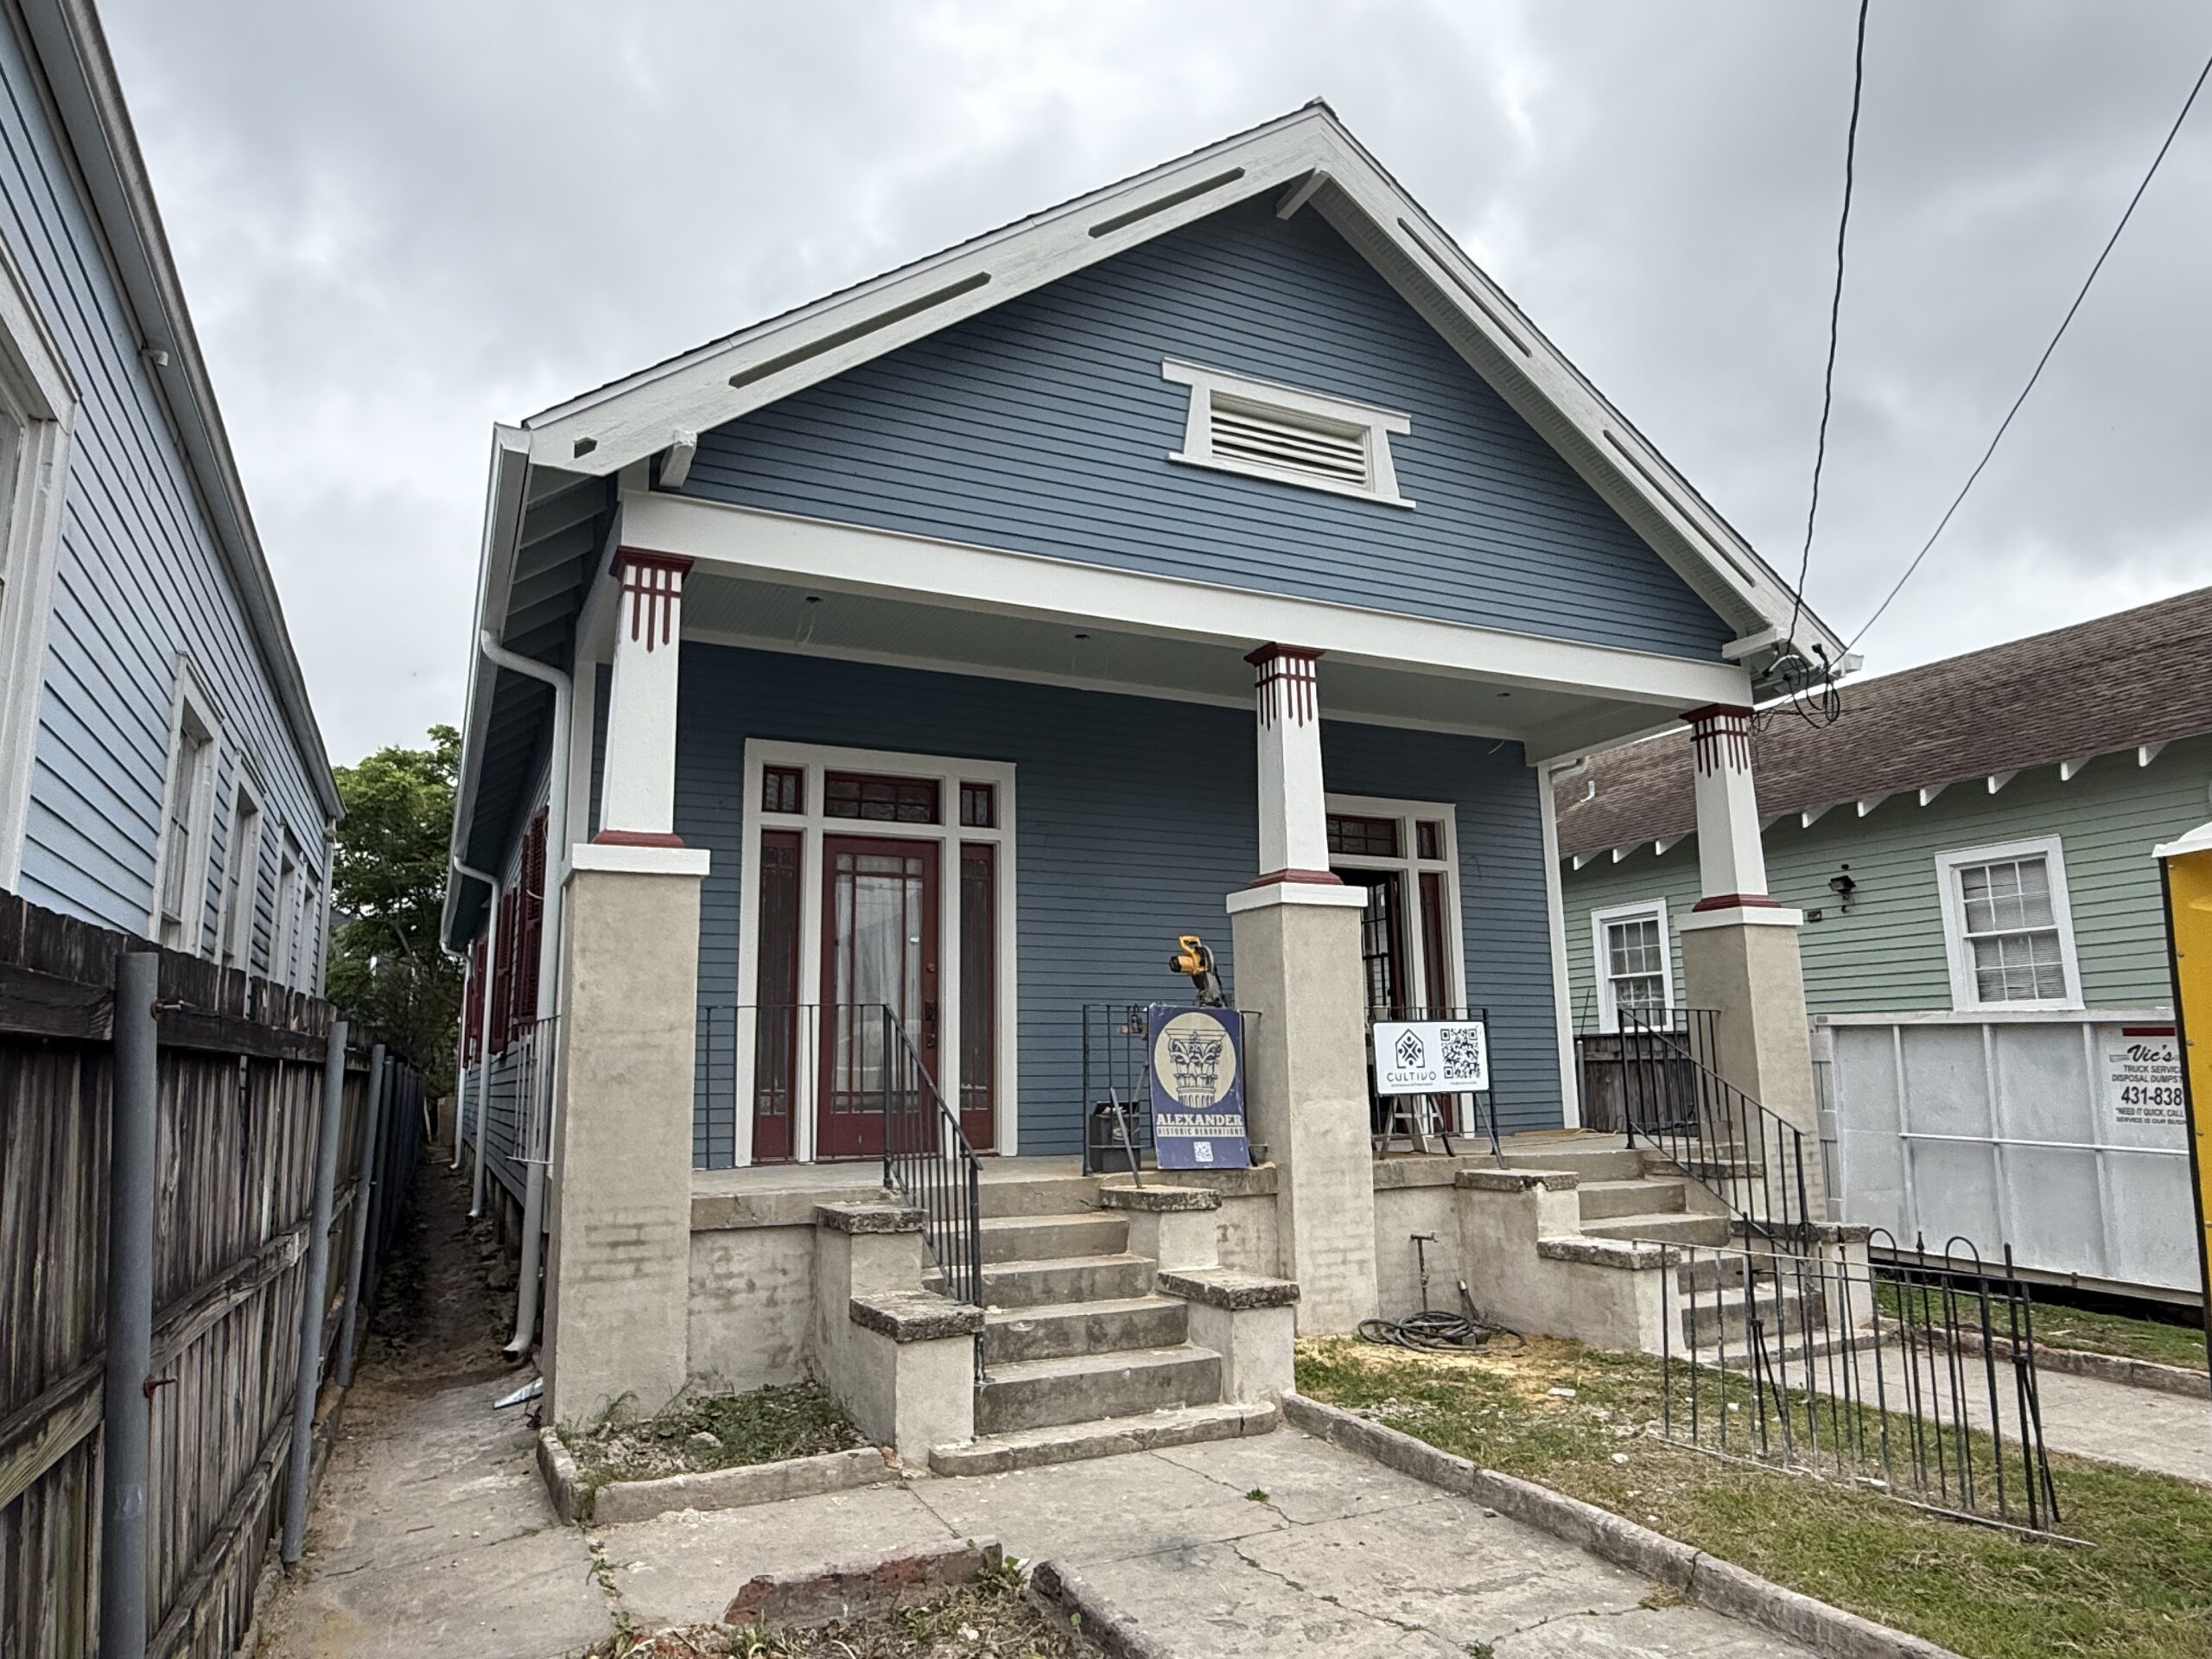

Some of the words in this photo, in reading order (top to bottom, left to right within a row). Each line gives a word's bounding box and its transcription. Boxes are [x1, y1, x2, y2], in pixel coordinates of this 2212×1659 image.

[2127, 1044, 2175, 1062] Vic's
[2124, 1065, 2149, 1073] TRUCK
[2151, 1065, 2181, 1074] SERVIC
[1387, 1071, 1437, 1082] CULTIVO
[2112, 1074, 2149, 1083] DISPOSAL
[2150, 1075, 2183, 1084] DUMPST
[2121, 1085, 2183, 1106] 431-838
[1156, 1113, 1243, 1126] ALEXANDER
